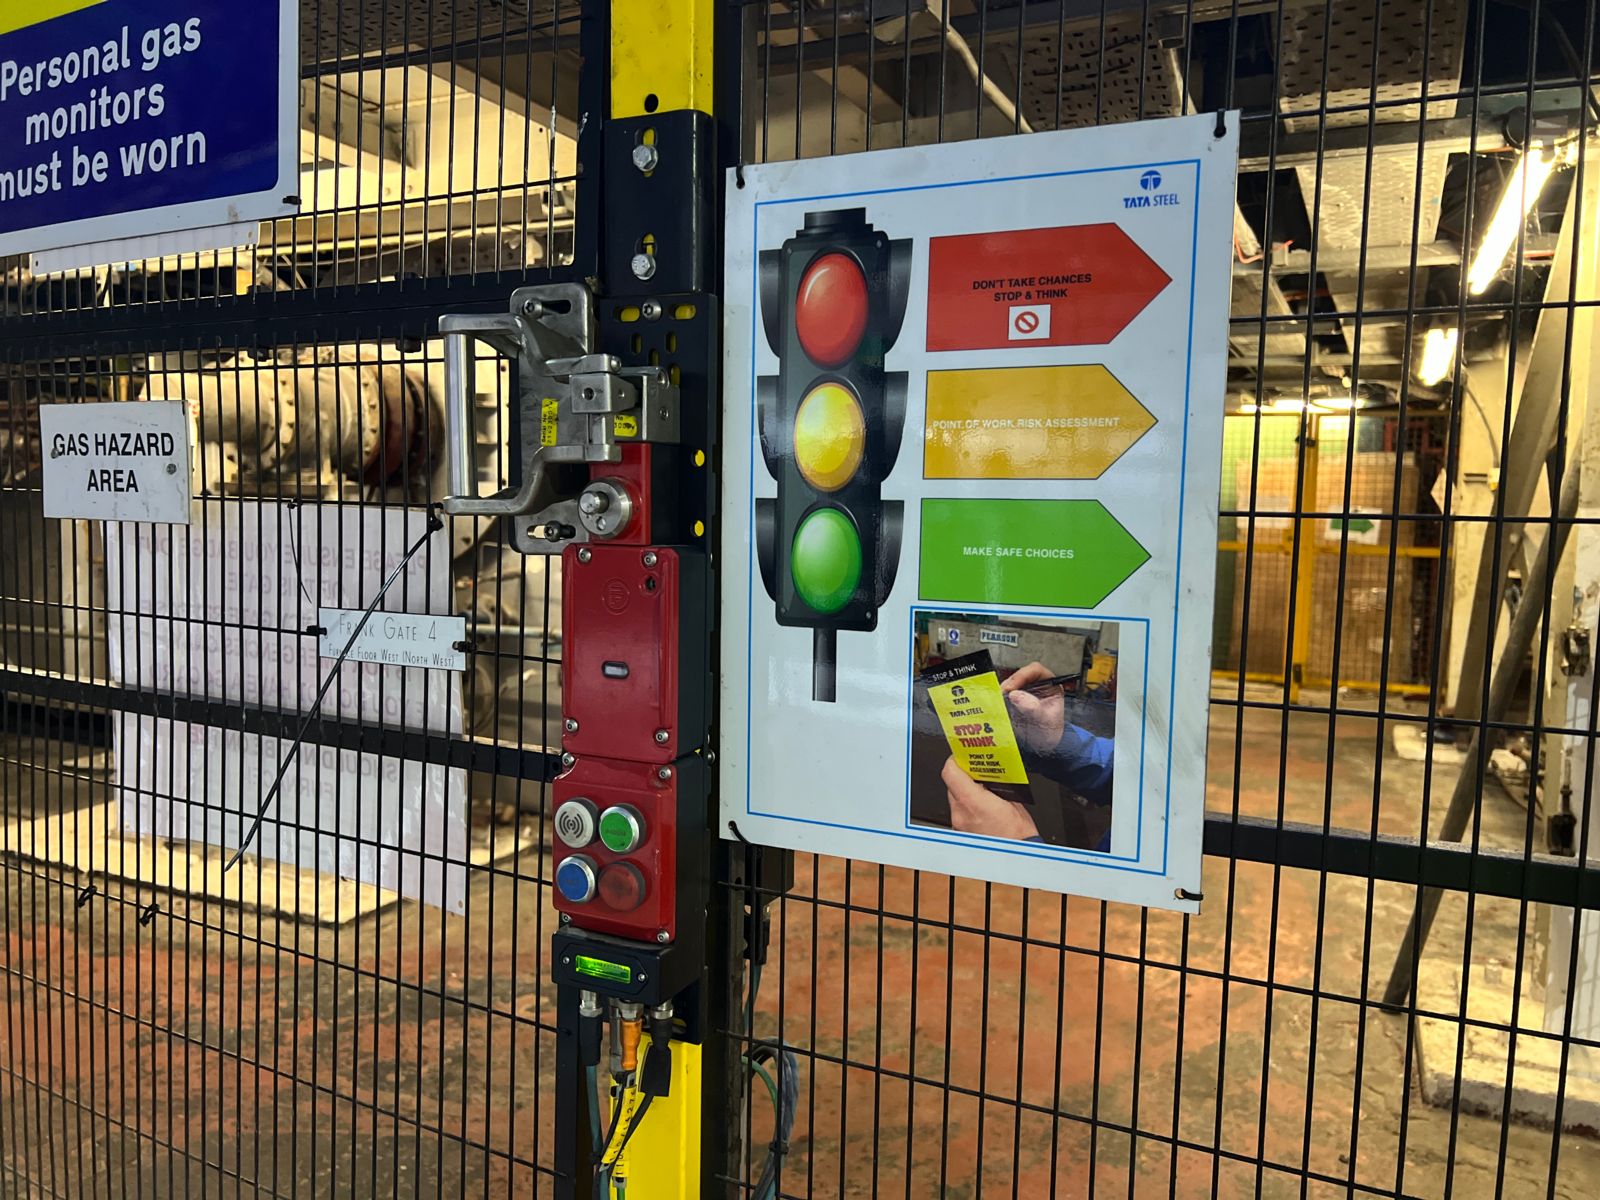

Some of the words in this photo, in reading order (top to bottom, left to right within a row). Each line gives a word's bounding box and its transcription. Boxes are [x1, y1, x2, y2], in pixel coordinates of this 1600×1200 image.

[1, 26, 130, 100] Personal
[141, 17, 201, 71] gas
[25, 83, 165, 145] monitors
[0, 150, 62, 200] must
[72, 146, 109, 187] be
[119, 131, 206, 177] worn
[1123, 196, 1151, 208] TATA
[1153, 193, 1180, 206] STEEL
[972, 280, 1005, 290] DON'T
[1008, 277, 1035, 287] TAKE
[1038, 273, 1092, 286] CHANCES
[994, 291, 1022, 302] STOP
[1024, 290, 1032, 300] &
[1036, 288, 1068, 299] THINK
[932, 419, 961, 429] POINT
[965, 419, 979, 428] OF
[982, 418, 1014, 428] WORK
[1018, 417, 1042, 427] RISK
[1045, 416, 1120, 428] ASSESSMENT
[53, 433, 90, 456] GAS
[95, 432, 174, 457] HAZARD
[86, 469, 139, 493] AREA
[963, 547, 992, 556] MAKE
[996, 548, 1022, 557] SAFE
[1025, 548, 1074, 559] CHOICES
[383, 616, 417, 641] GATE
[428, 620, 436, 640] 4
[932, 671, 947, 681] STOP
[954, 664, 977, 676] THINK
[953, 697, 970, 705] TATA
[954, 723, 982, 736] STOP
[983, 722, 993, 733] &
[959, 736, 996, 748] THINK
